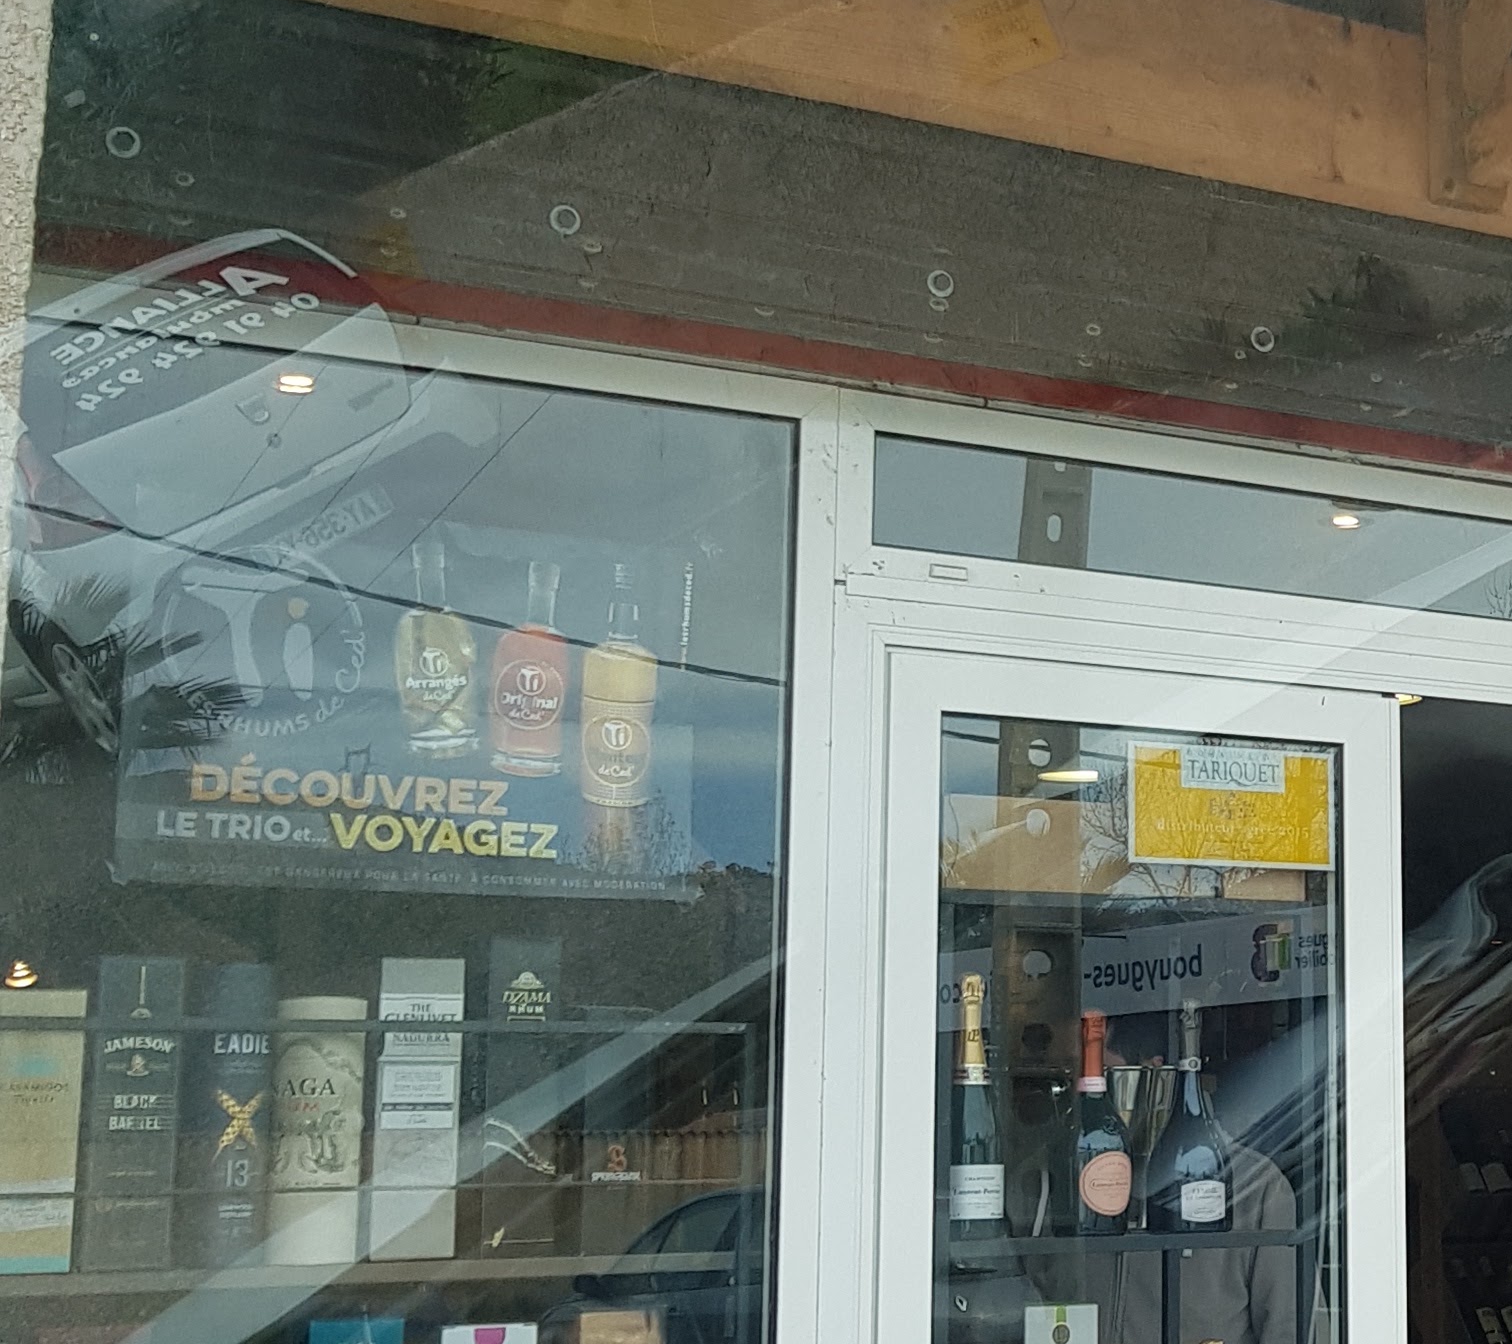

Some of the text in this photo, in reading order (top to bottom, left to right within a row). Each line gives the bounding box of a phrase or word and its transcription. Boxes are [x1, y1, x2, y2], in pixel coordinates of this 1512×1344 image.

[190, 752, 509, 816] DÉCOUVREZ
[1188, 759, 1279, 786] TARIQUET
[157, 810, 197, 838] LE
[206, 813, 291, 843] TRIO
[329, 813, 558, 859] VOYAGEZ
[104, 1036, 176, 1054] JAMESON
[225, 1159, 249, 1188] 13
